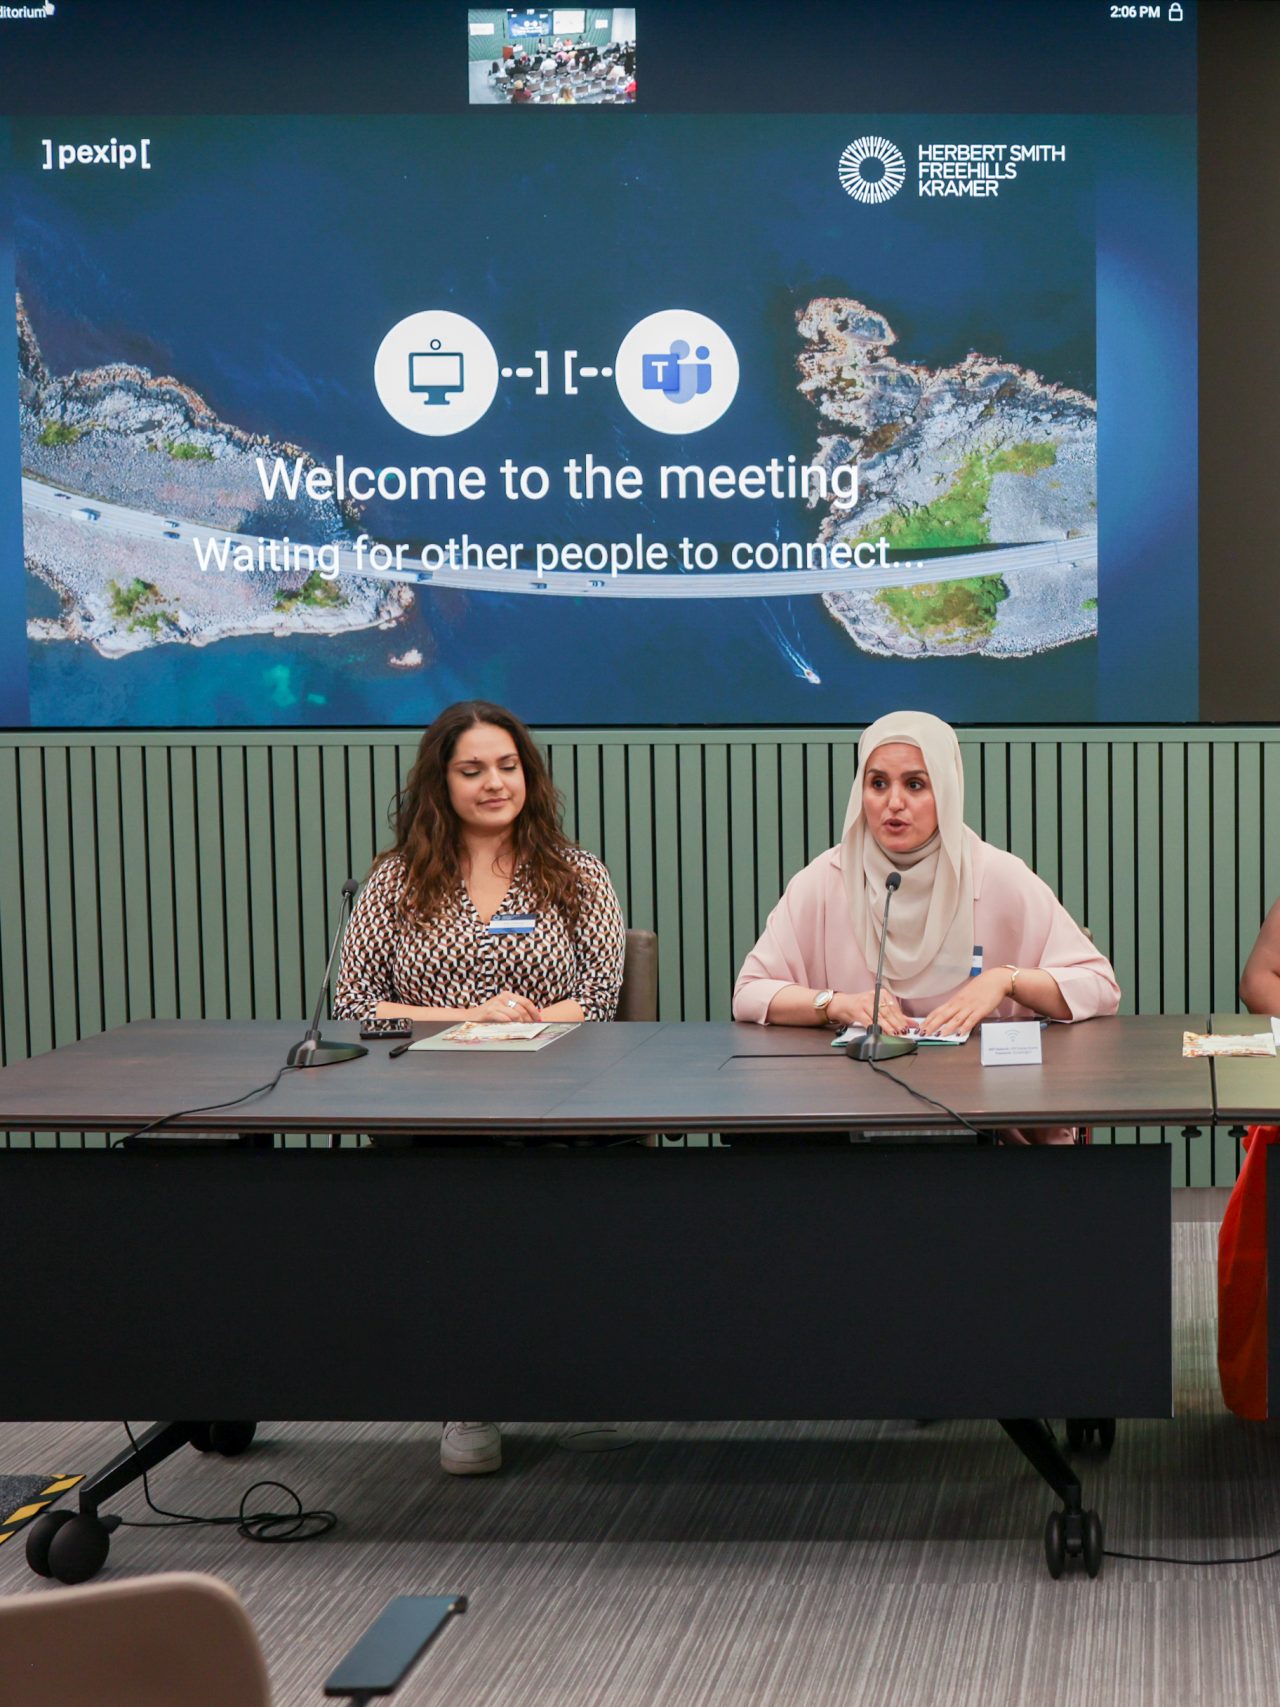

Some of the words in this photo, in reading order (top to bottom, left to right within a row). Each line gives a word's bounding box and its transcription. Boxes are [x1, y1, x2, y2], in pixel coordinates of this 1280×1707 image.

[1111, 6, 1137, 18] 2:06
[1140, 6, 1160, 18] PM
[919, 145, 1006, 162] HERBERT
[1009, 145, 1065, 162] SMITH
[919, 163, 1017, 180] FREEHILLS
[919, 180, 998, 197] KRAMER
[652, 363, 668, 382] T
[256, 455, 486, 501] Welcome
[501, 459, 549, 500] to
[564, 455, 642, 500] the
[660, 455, 859, 509] meeting
[192, 536, 340, 578] Waiting
[355, 534, 411, 571] for
[421, 534, 524, 571] other
[536, 532, 668, 578] people
[680, 535, 719, 570] to
[731, 538, 924, 569] connect...
